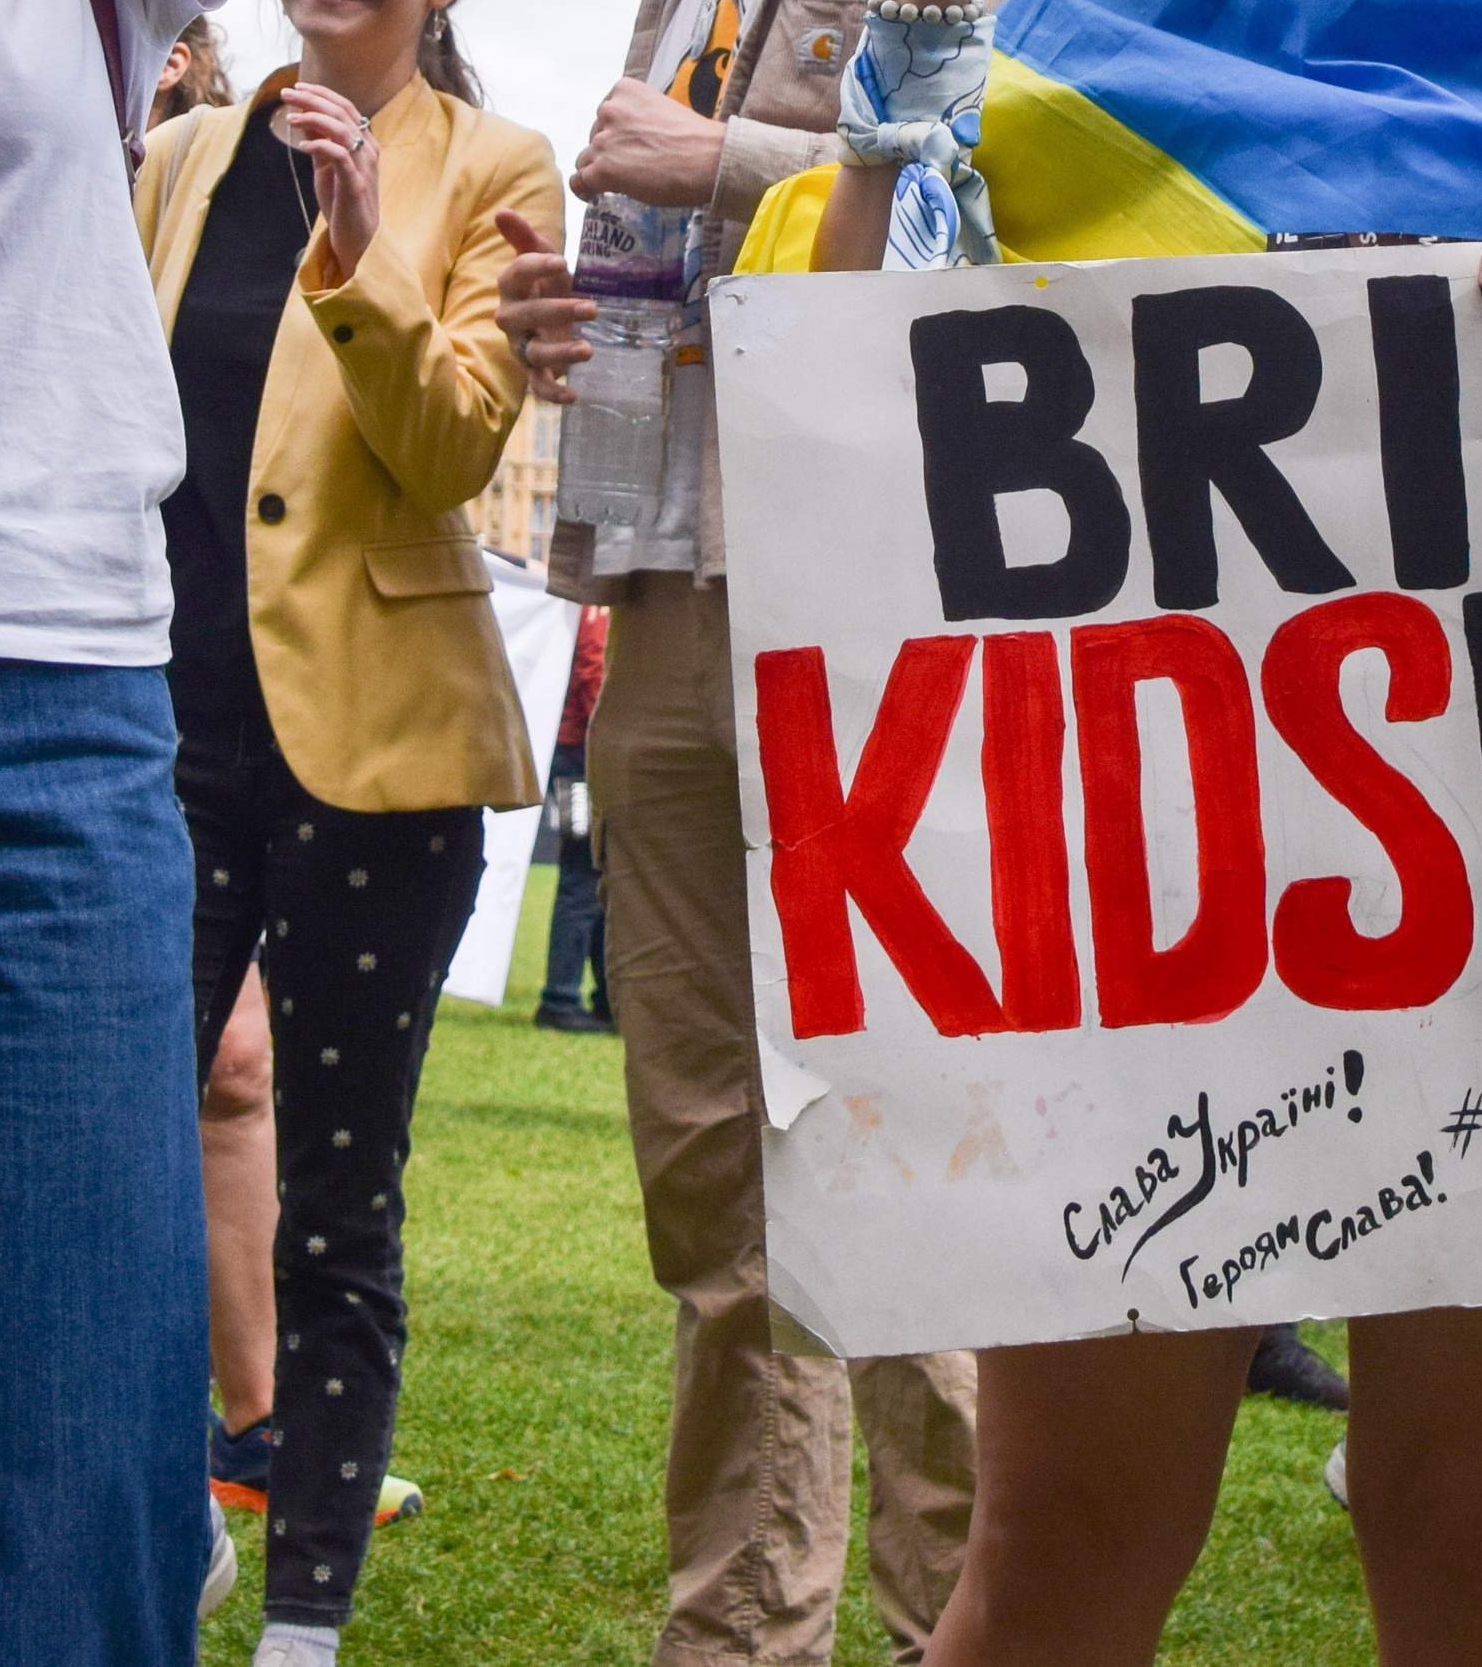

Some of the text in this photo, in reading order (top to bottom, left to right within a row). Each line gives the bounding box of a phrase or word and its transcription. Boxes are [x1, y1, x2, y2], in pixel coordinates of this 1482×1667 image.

[755, 591, 1475, 1040] KIDS
[1064, 1049, 1365, 1283] Слава Україні!
[1305, 1150, 1449, 1261] Слава!
